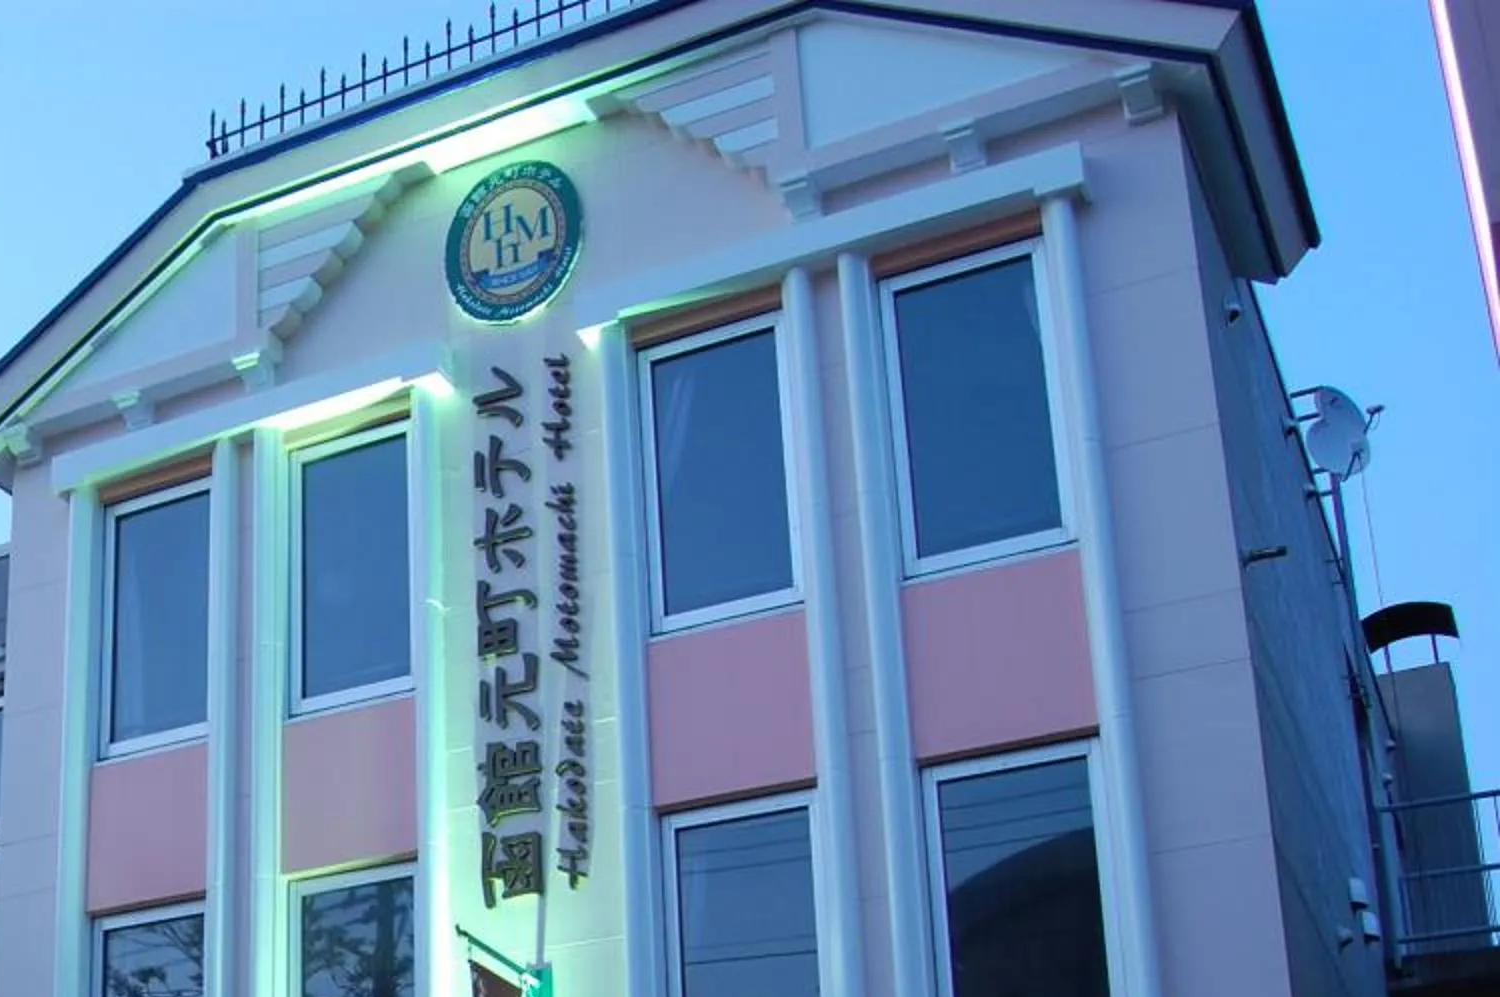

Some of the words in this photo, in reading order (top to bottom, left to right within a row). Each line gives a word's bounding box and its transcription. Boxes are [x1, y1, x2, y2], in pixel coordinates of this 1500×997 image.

[541, 352, 574, 462] Hotel
[472, 366, 545, 909] 函館元町ホテル
[544, 482, 590, 681] Motomachi
[555, 699, 589, 890] Hakodate
